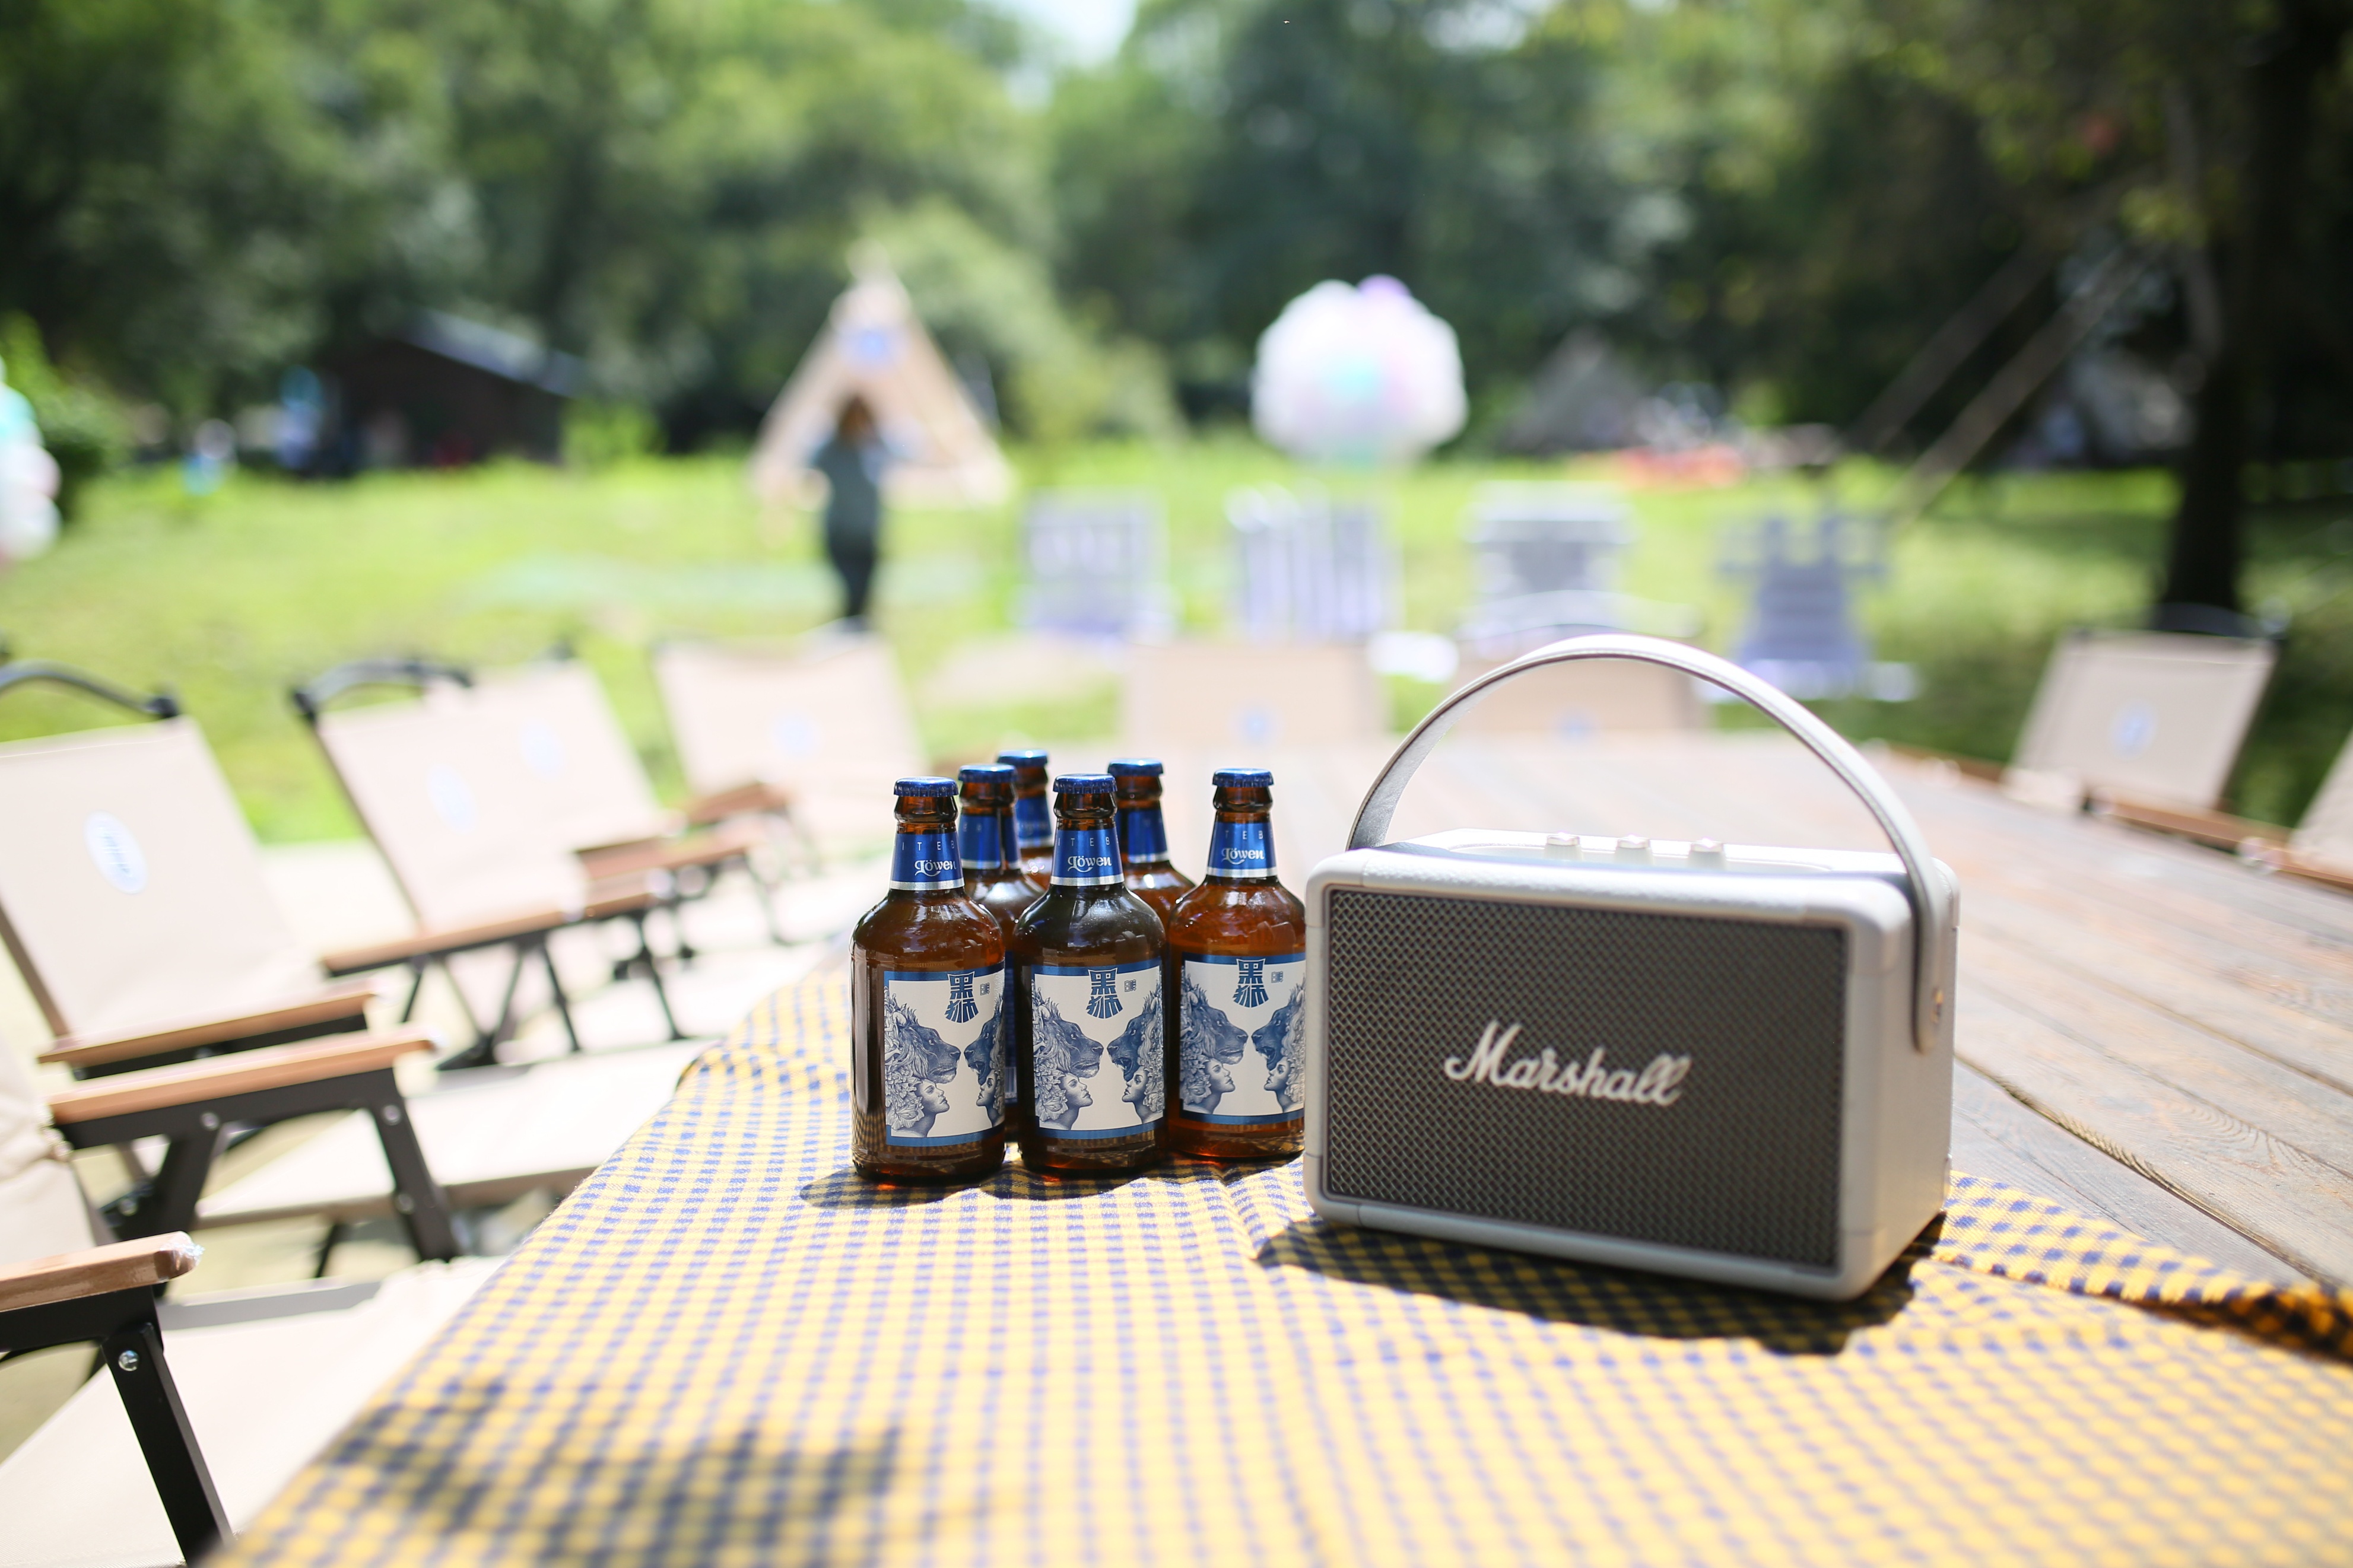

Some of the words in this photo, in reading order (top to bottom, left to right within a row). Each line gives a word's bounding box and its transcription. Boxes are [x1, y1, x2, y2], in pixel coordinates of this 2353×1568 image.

[1067, 855, 1112, 873] Löwen
[1221, 847, 1265, 865] Löwen
[914, 859, 957, 877] Löwen
[1443, 1019, 1692, 1106] Marshall
